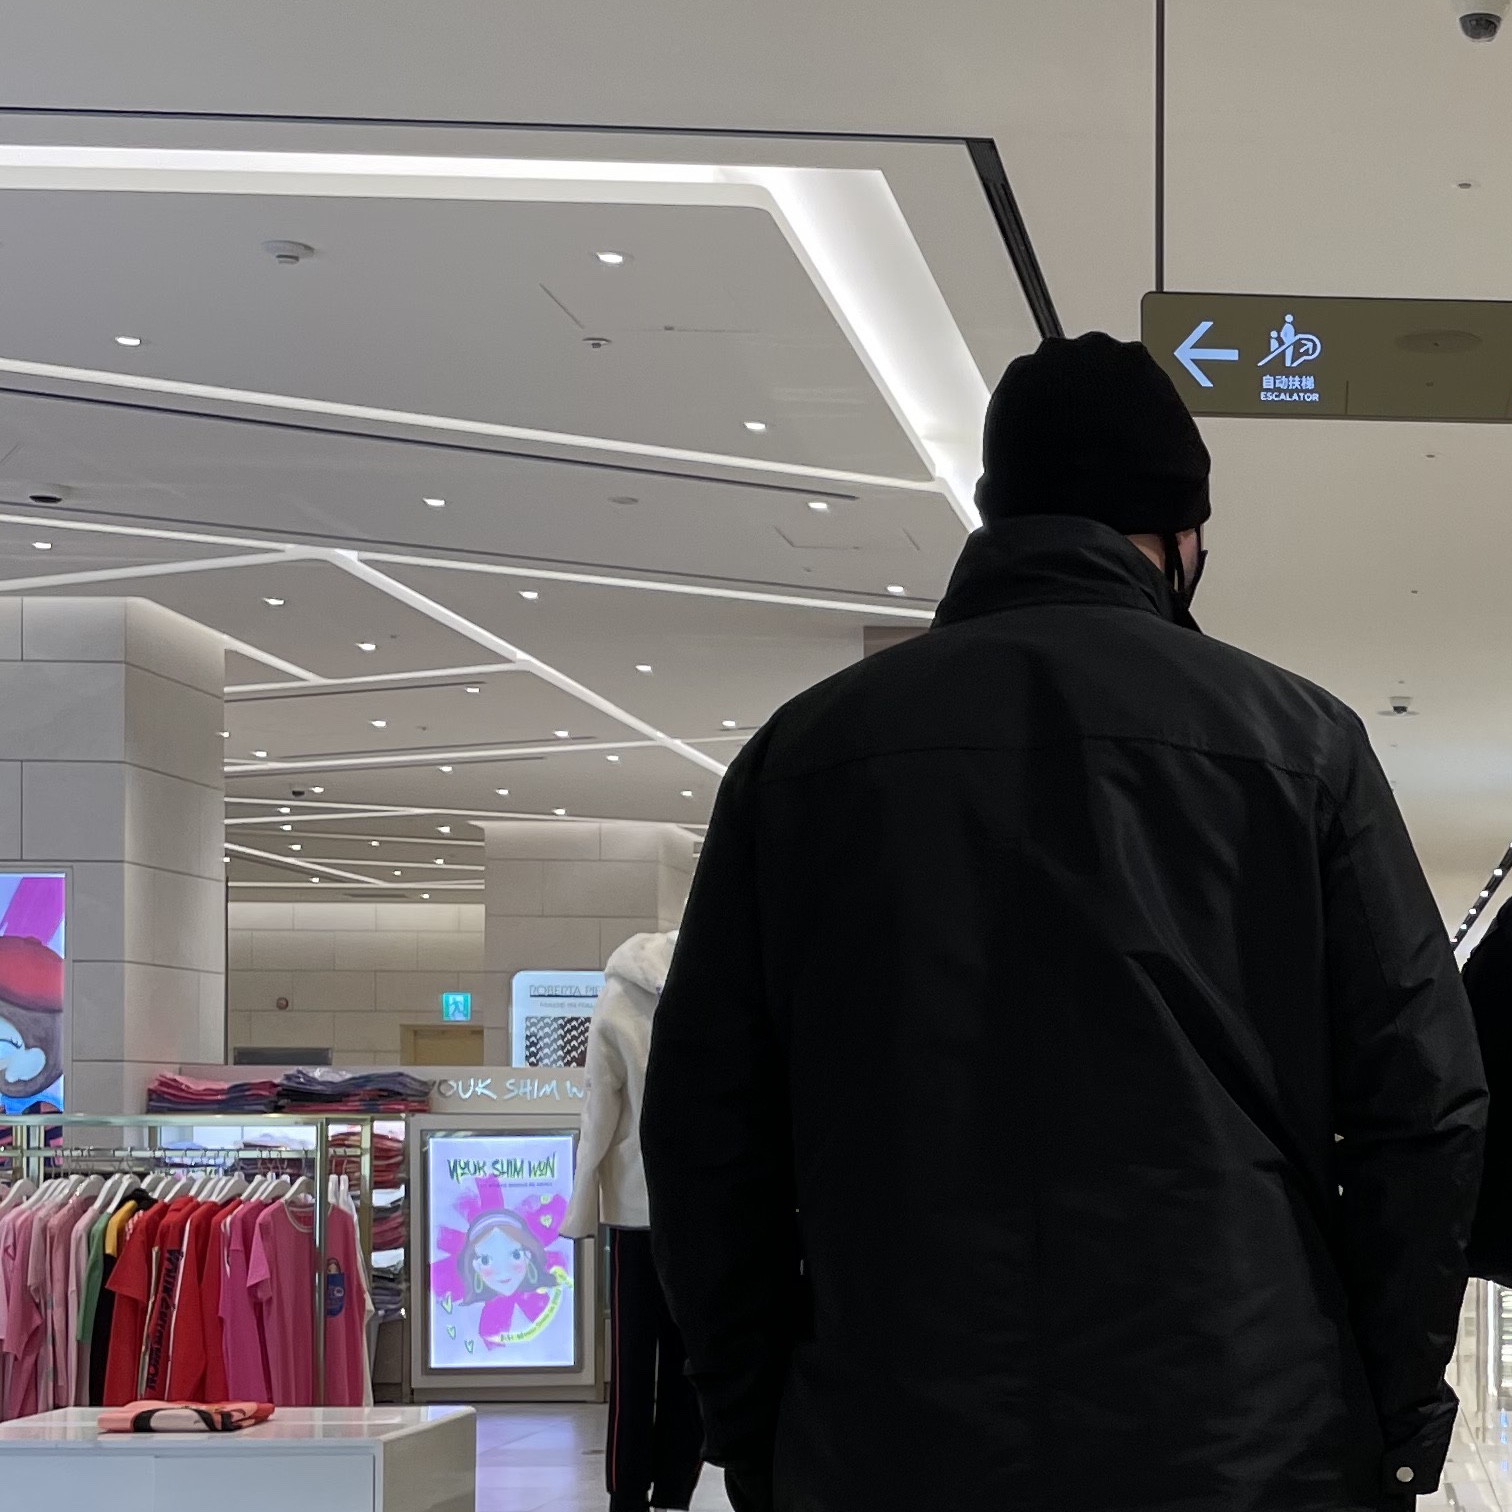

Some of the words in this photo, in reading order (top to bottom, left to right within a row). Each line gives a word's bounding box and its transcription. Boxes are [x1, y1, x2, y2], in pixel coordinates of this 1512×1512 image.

[1262, 374, 1315, 390] 自动扶梯
[1260, 391, 1320, 402] ESCALATOR
[432, 1077, 498, 1101] OUK
[504, 1078, 561, 1101] SHIM
[491, 1158, 525, 1179] SHIM
